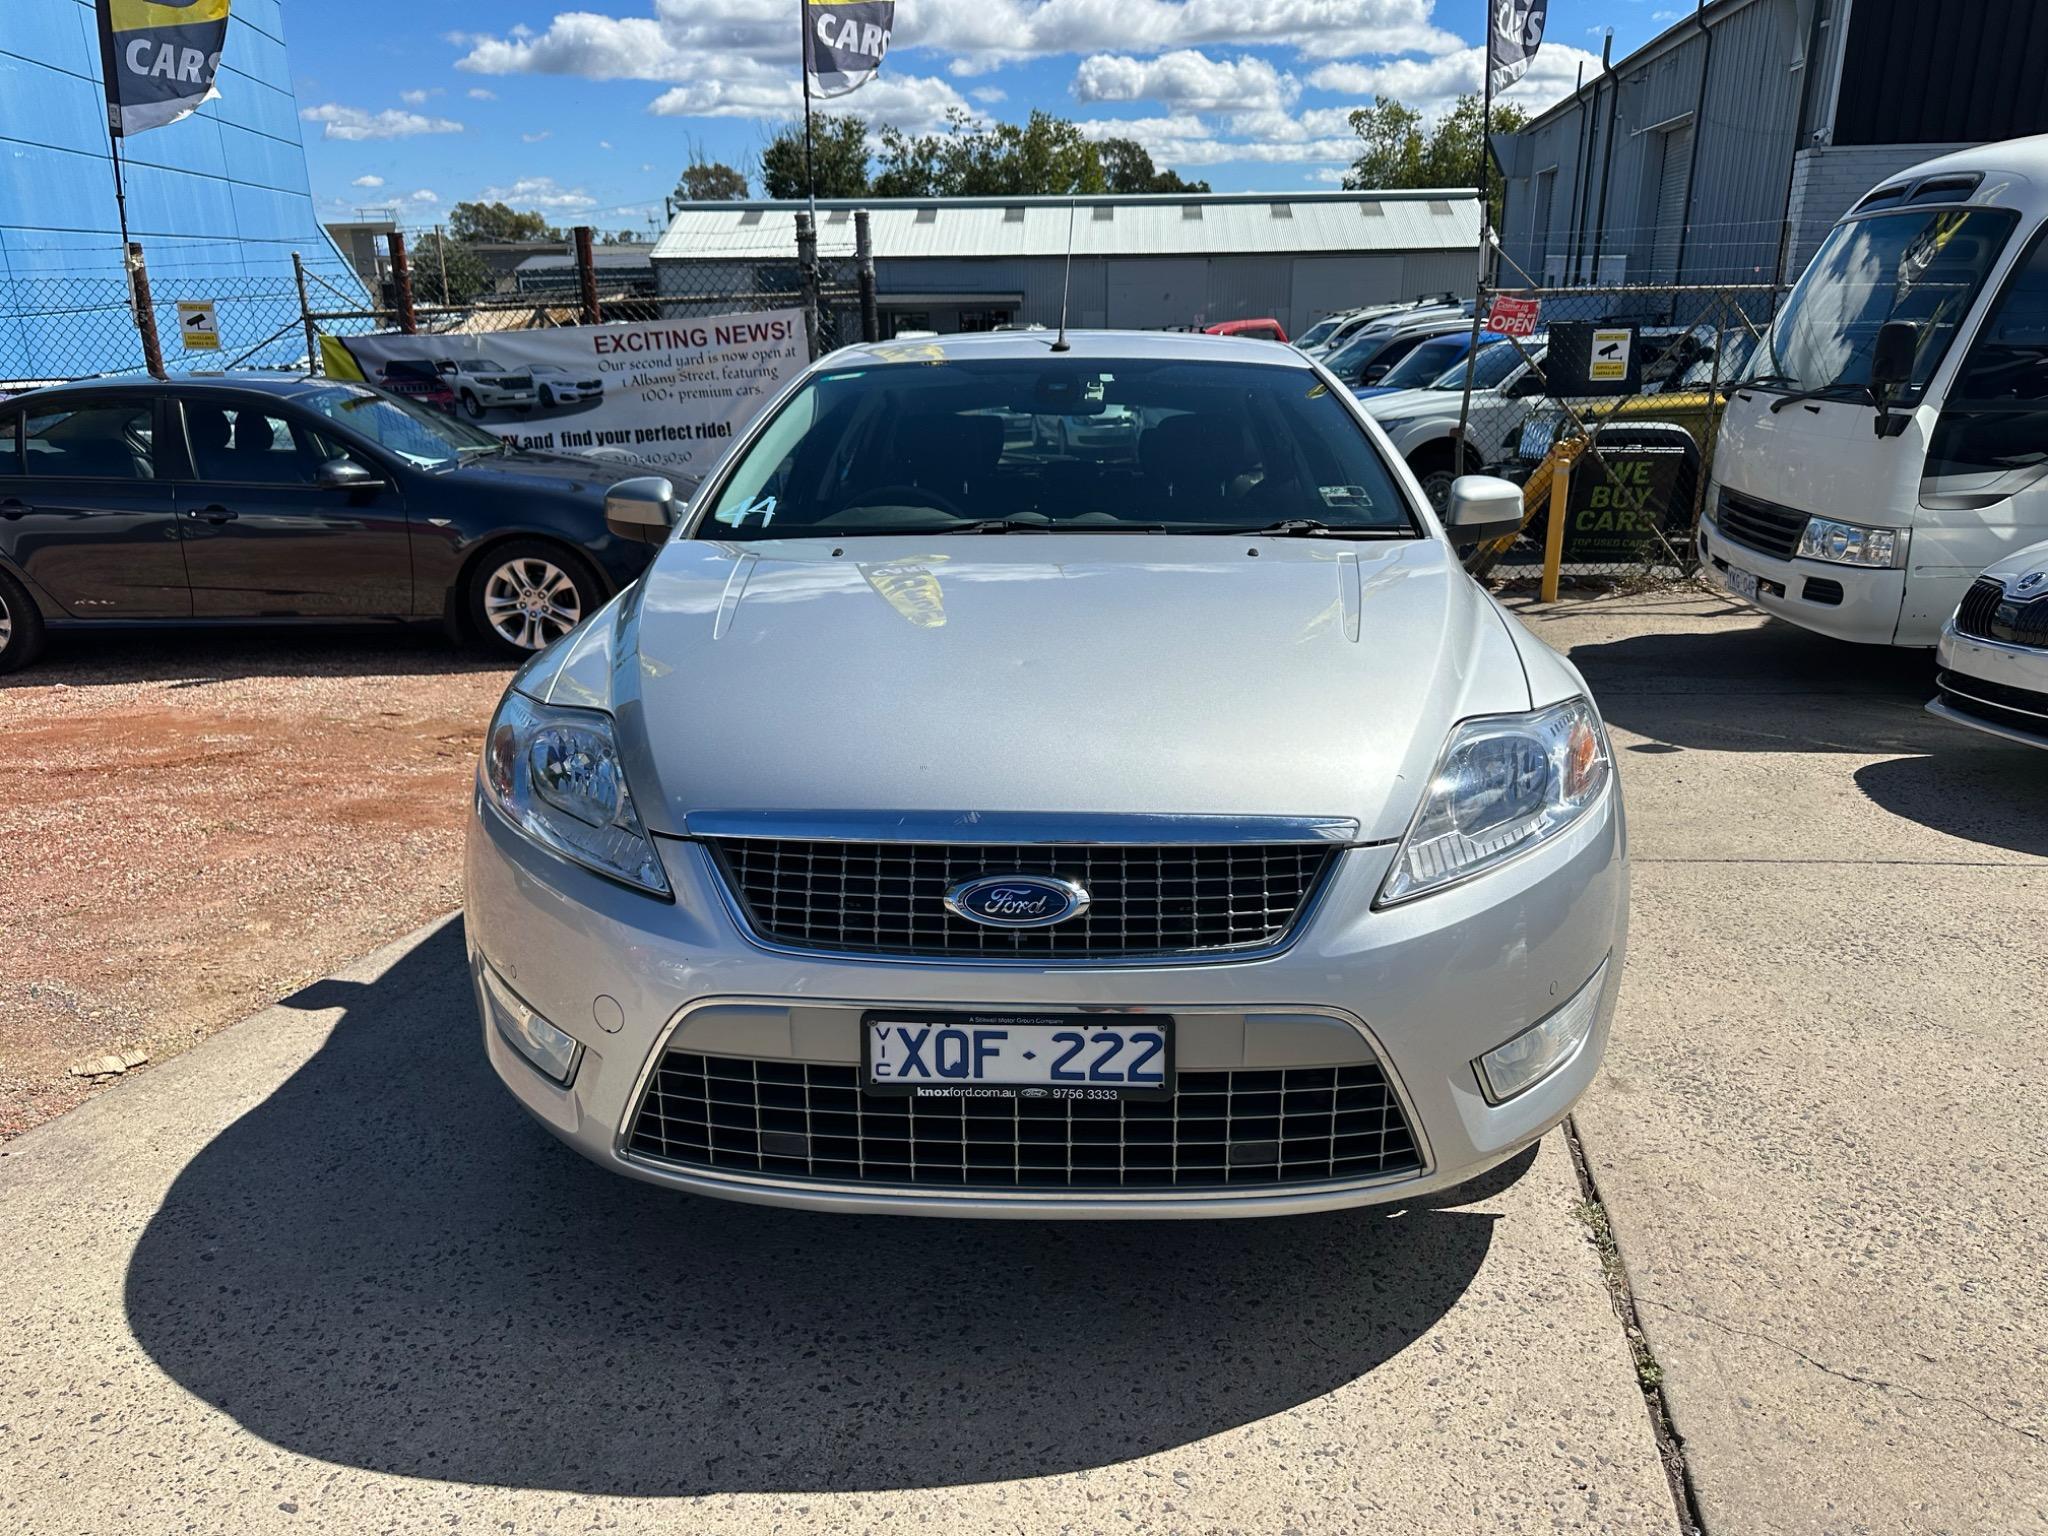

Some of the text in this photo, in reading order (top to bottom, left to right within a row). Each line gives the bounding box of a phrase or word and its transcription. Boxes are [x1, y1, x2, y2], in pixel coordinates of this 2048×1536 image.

[1491, 315, 1536, 332] OPEN
[594, 320, 793, 355] EXCITING NEWS!
[598, 347, 798, 373] Our second yard is now open at
[630, 372, 677, 389] Albany
[722, 366, 779, 382] featuring
[678, 387, 733, 404] premium
[735, 385, 764, 397] cars.
[524, 432, 554, 450] and
[561, 430, 592, 448] find
[595, 430, 631, 449] your
[635, 423, 694, 445] perfect
[695, 421, 732, 440] ride!
[1606, 461, 1654, 484] WE
[1590, 485, 1654, 509] BUY
[984, 888, 1048, 914] Ford
[897, 1028, 1165, 1082] XQF 222
[916, 1086, 1017, 1099] knoxford.com.au
[1052, 1088, 1084, 1100] 9756
[1086, 1089, 1118, 1101] 3333
